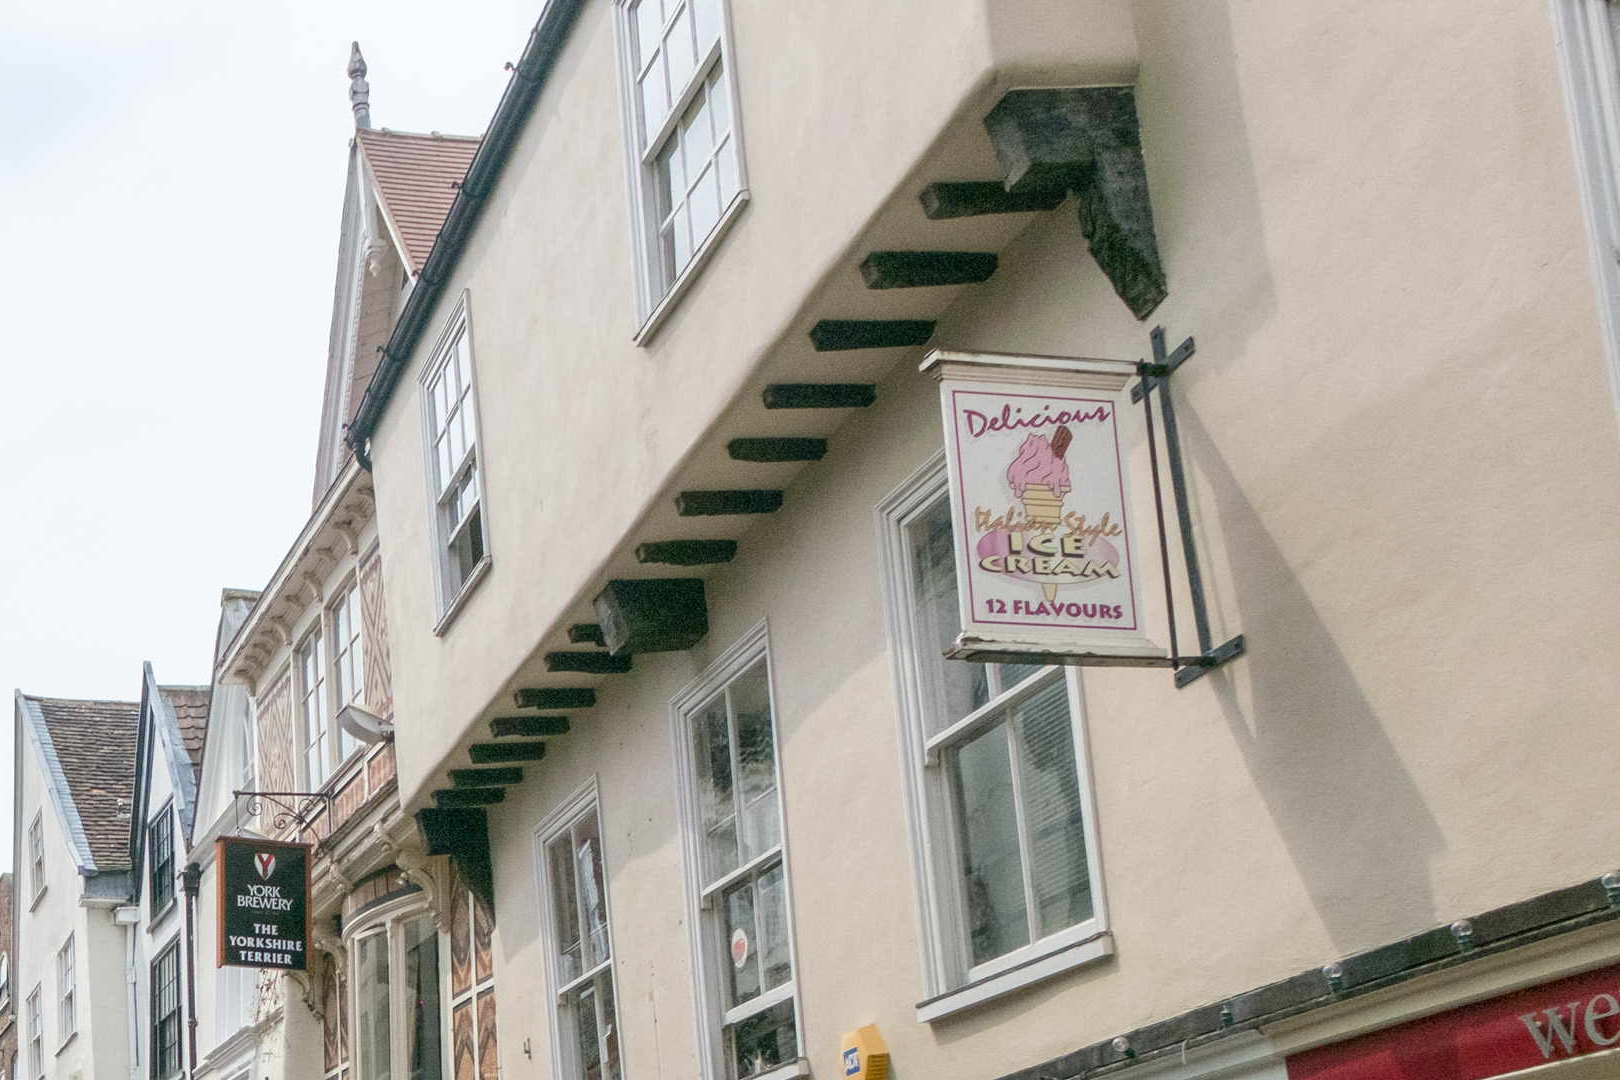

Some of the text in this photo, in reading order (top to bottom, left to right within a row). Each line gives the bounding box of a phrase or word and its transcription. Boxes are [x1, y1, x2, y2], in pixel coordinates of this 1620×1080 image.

[963, 404, 1111, 437] Delicious
[975, 506, 1122, 546] Italian Style
[1007, 532, 1087, 557] ICE
[979, 555, 1121, 579] CREAM
[986, 599, 1122, 619] 12 FLAVOURS
[247, 884, 280, 898] YORK
[237, 895, 293, 911] BREWERY
[254, 924, 278, 935] THE
[229, 936, 303, 951] YORKSHIRE
[240, 951, 292, 964] TERRIER
[845, 1052, 859, 1071] ADT
